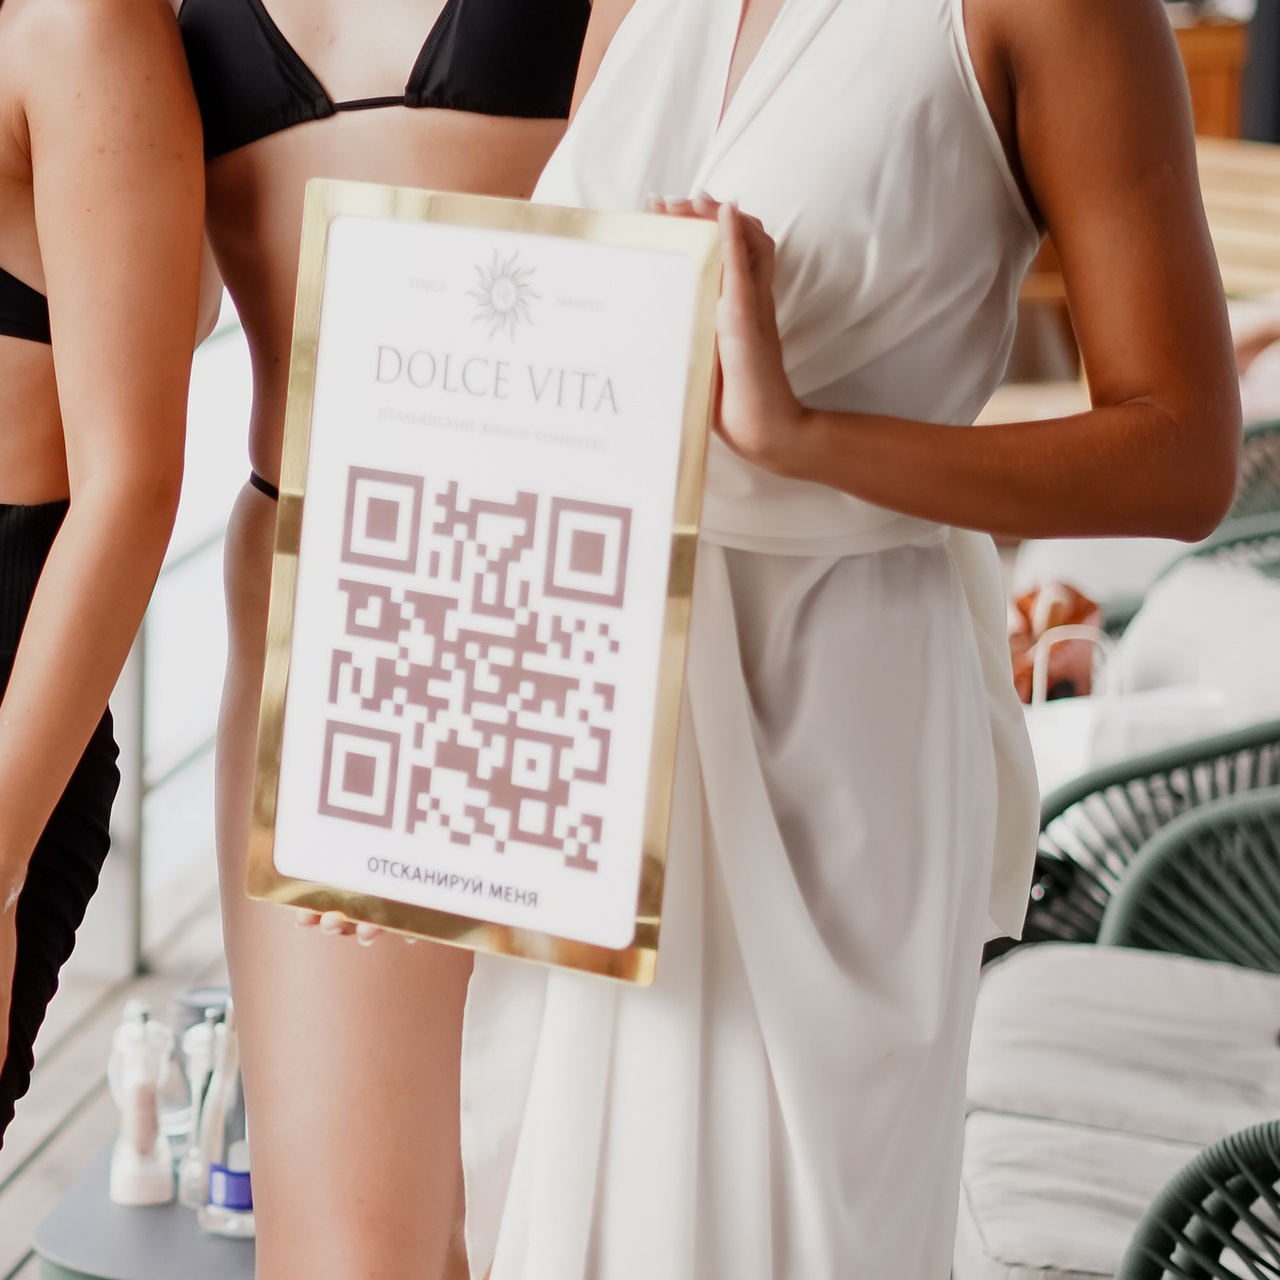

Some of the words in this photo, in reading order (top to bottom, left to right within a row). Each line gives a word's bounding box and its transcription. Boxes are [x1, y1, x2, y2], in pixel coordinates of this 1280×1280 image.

[373, 344, 511, 401] DOLCE
[525, 363, 621, 417] VITA
[367, 856, 483, 896] ОТСКАНИРУЙ
[488, 883, 539, 908] МЕНЯ
